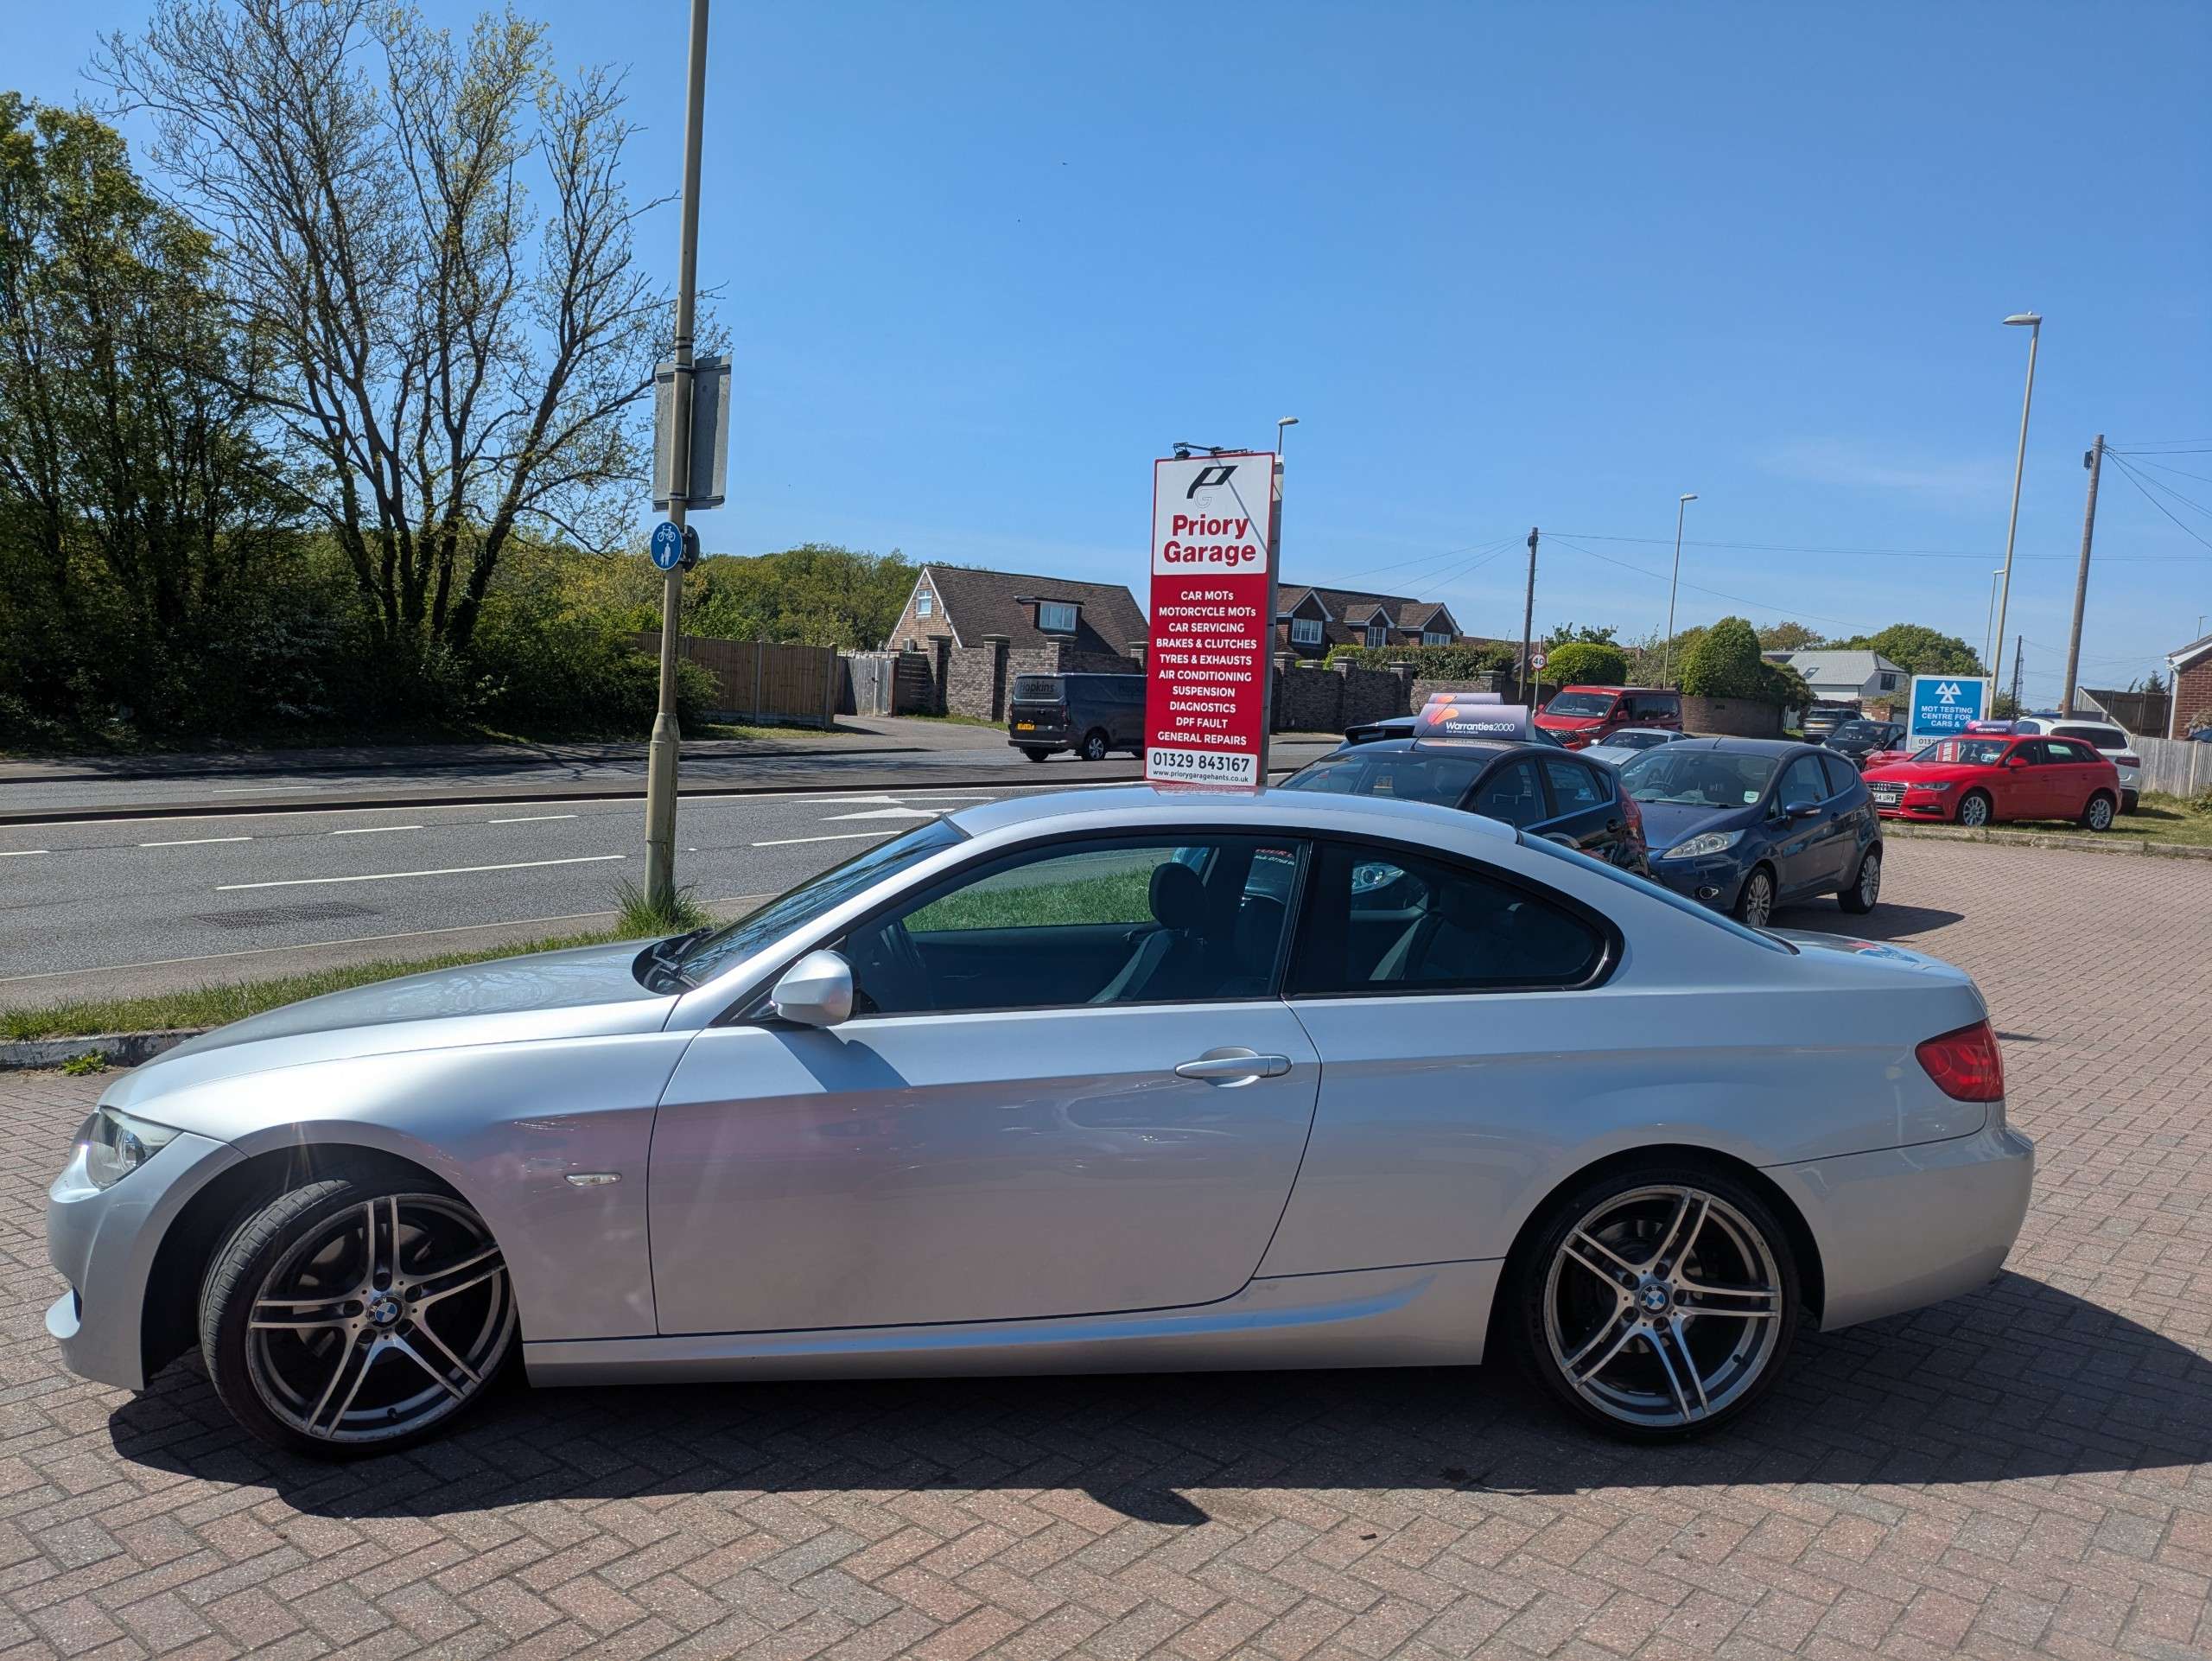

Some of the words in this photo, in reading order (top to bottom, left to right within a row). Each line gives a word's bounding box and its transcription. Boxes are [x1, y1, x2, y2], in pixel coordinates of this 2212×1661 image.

[1173, 513, 1249, 540] Priory
[1164, 540, 1256, 567] Garage
[1180, 591, 1202, 601] CAR
[1205, 591, 1234, 601] MOTs
[1159, 607, 1225, 617] MOTORCYCLE
[1228, 608, 1256, 617] MOTs
[1168, 623, 1189, 633] CAR
[1191, 623, 1245, 633] SERVICING
[1156, 639, 1194, 648] BRAKES
[1195, 639, 1203, 648] &
[1205, 640, 1257, 649] CLUTCHES
[1159, 654, 1189, 664] TYRES
[1191, 655, 1198, 664] &
[1199, 655, 1252, 665] EXHAUSTS
[1158, 670, 1176, 679] AIR
[1177, 671, 1252, 682] CONDITIONING
[1172, 686, 1236, 697] SUSPENSION
[1169, 701, 1236, 713] DIAGNOSTICS
[1176, 716, 1195, 726] DPF
[1197, 718, 1228, 729] FAULT
[1446, 721, 1515, 732] Warranties2000
[1157, 731, 1202, 743] GENERAL
[1204, 735, 1247, 746] REPAIRS
[1153, 752, 1193, 768] 01329
[1198, 755, 1250, 772] 843167
[1153, 769, 1249, 782] www.priorygaragehants.co.uk
